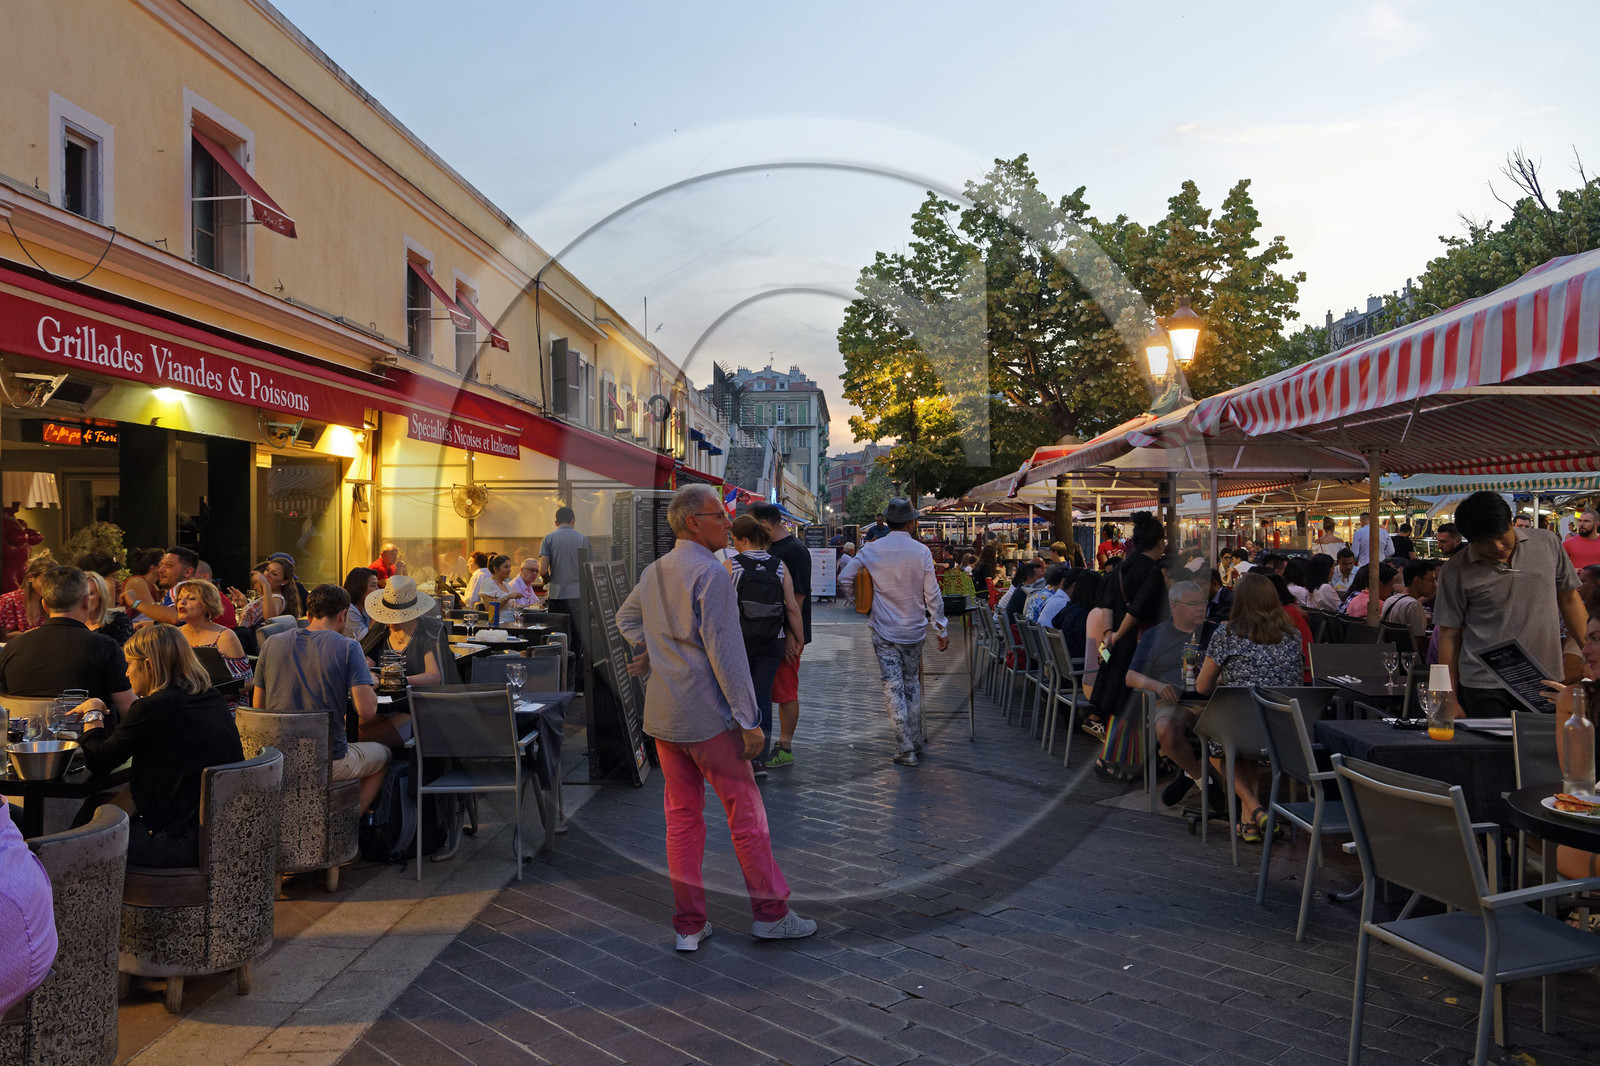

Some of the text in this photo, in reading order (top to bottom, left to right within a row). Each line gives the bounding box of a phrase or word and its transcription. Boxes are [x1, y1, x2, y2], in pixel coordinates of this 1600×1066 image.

[37, 315, 310, 412] Grillades Viandes & Poissons
[94, 430, 118, 443] Fiori
[412, 413, 518, 456] Spécialités Niçoises et Italiennes
